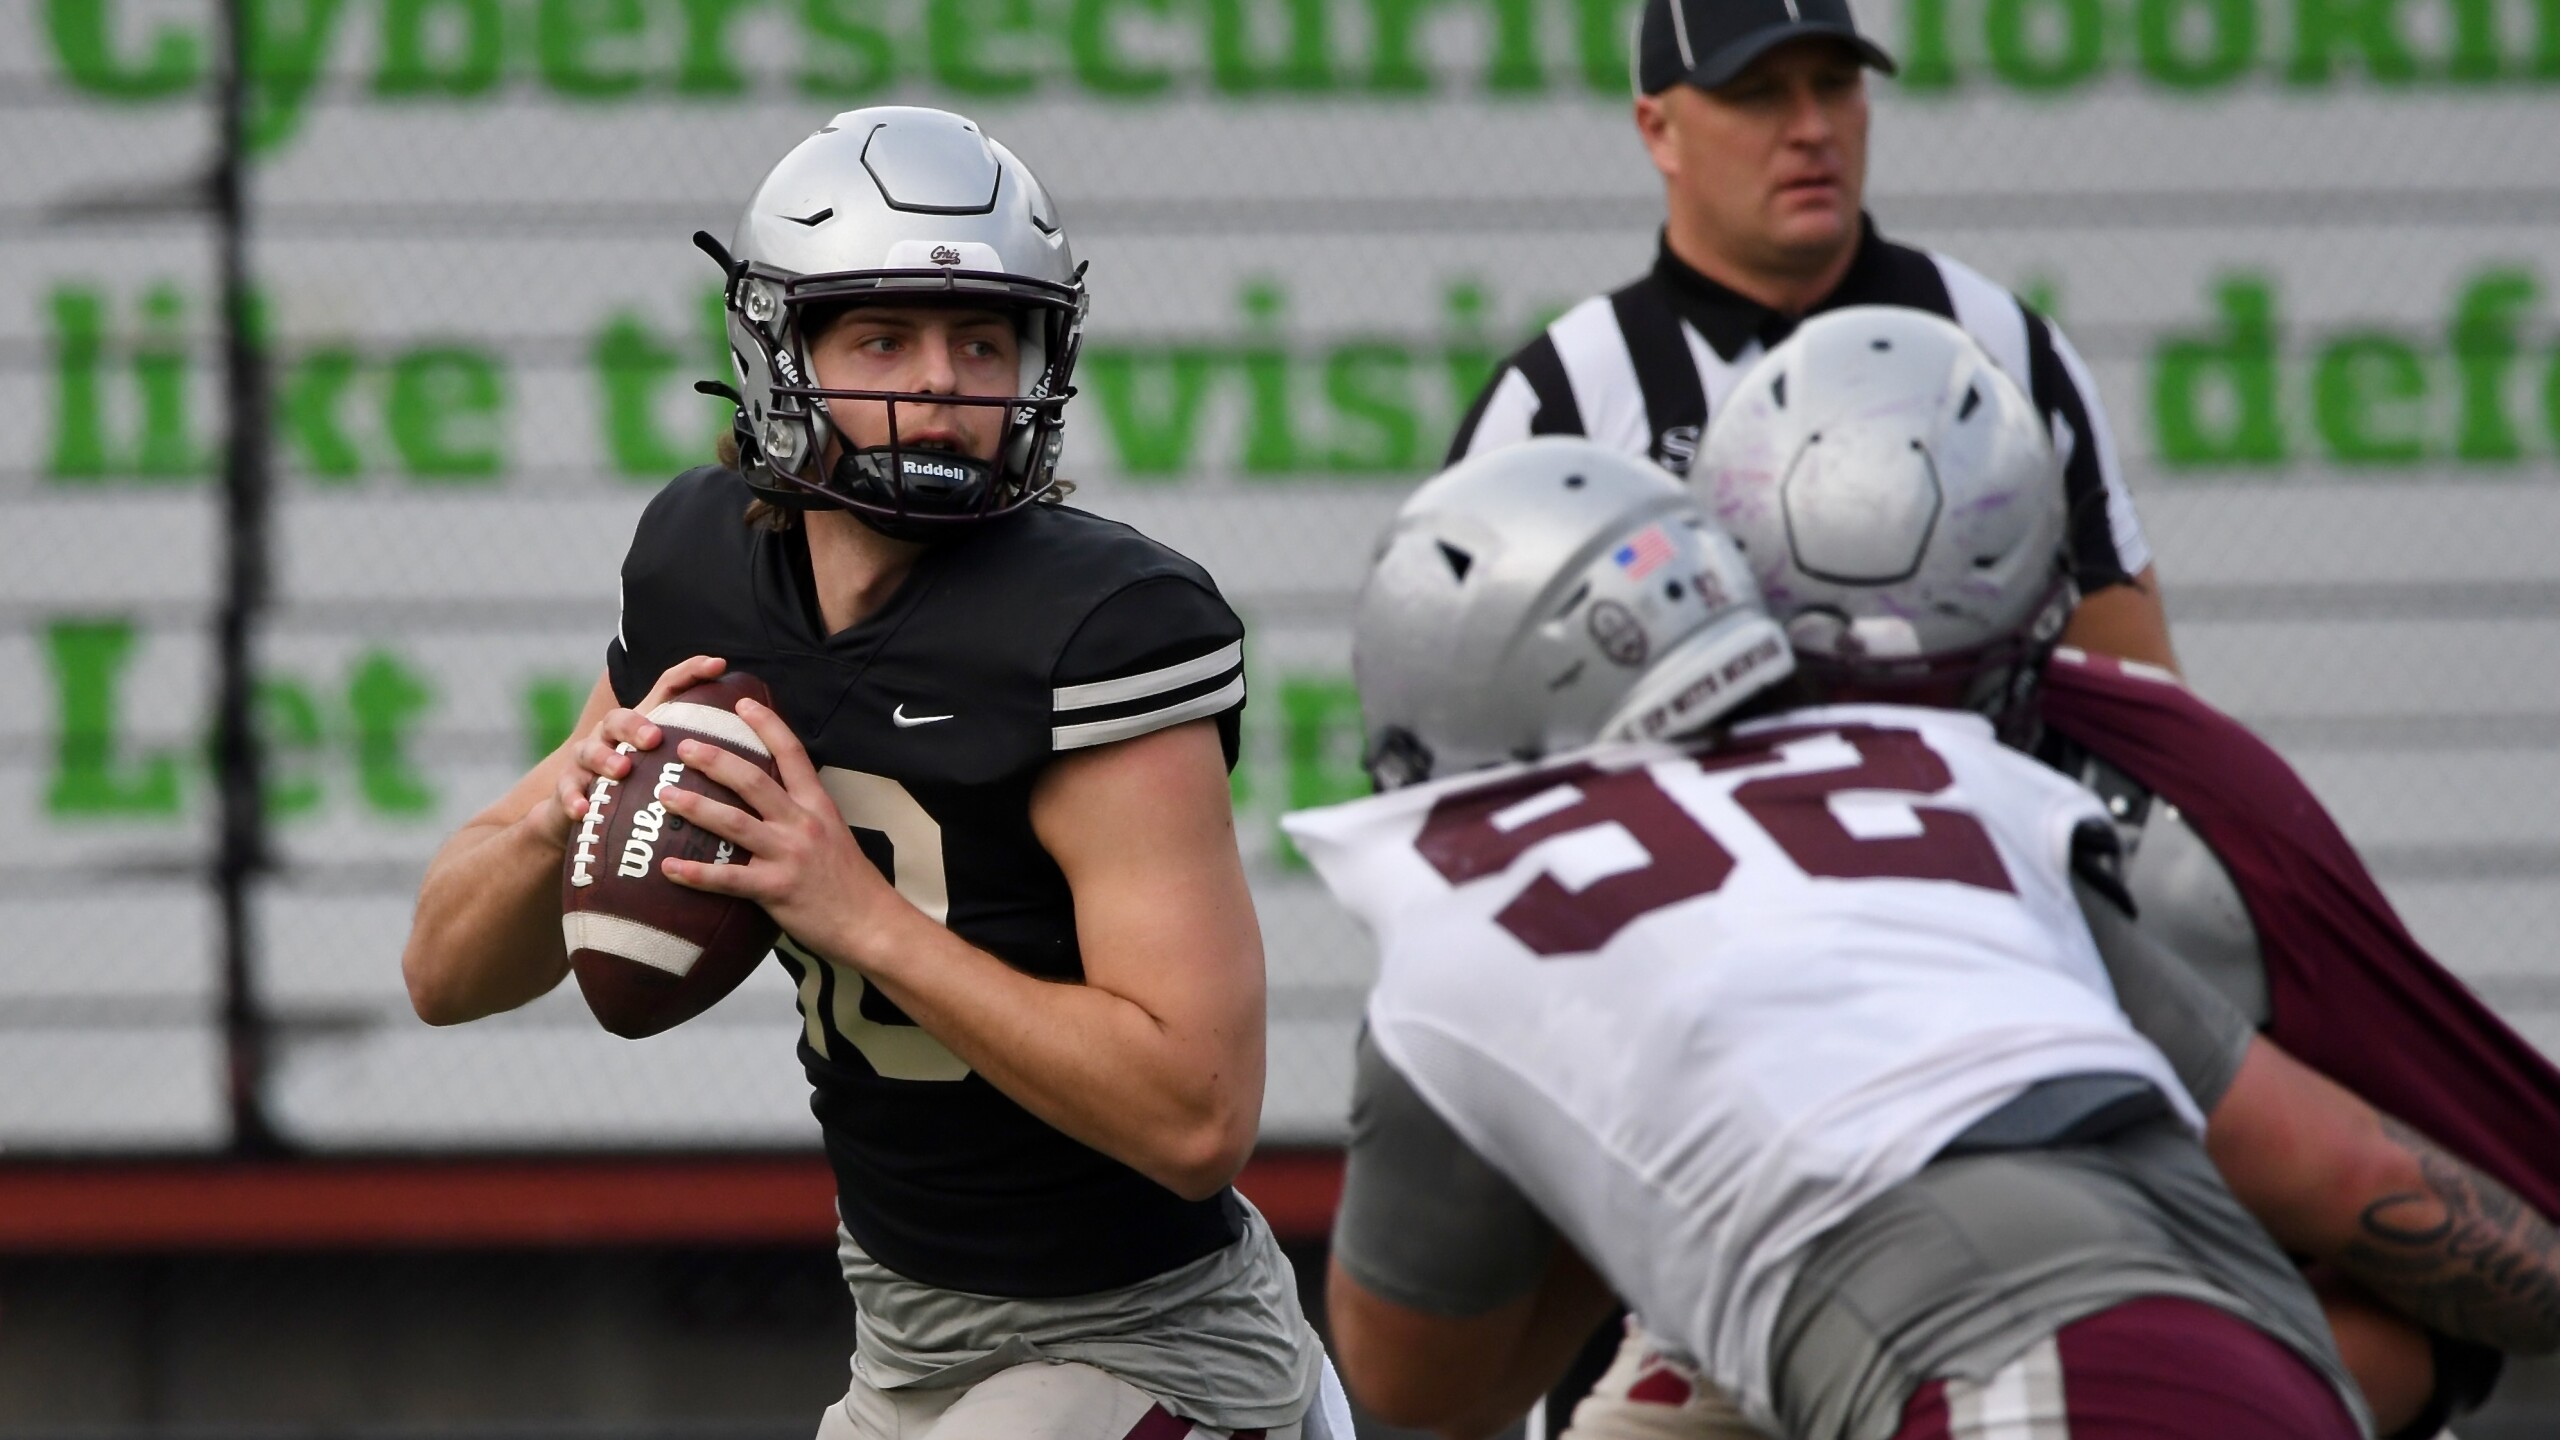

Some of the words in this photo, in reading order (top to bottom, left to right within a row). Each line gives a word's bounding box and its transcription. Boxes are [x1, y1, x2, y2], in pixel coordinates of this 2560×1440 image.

[929, 245, 961, 265] Griz
[2147, 267, 2560, 472] def
[903, 461, 964, 480] Riddell
[1413, 721, 2020, 958] 92
